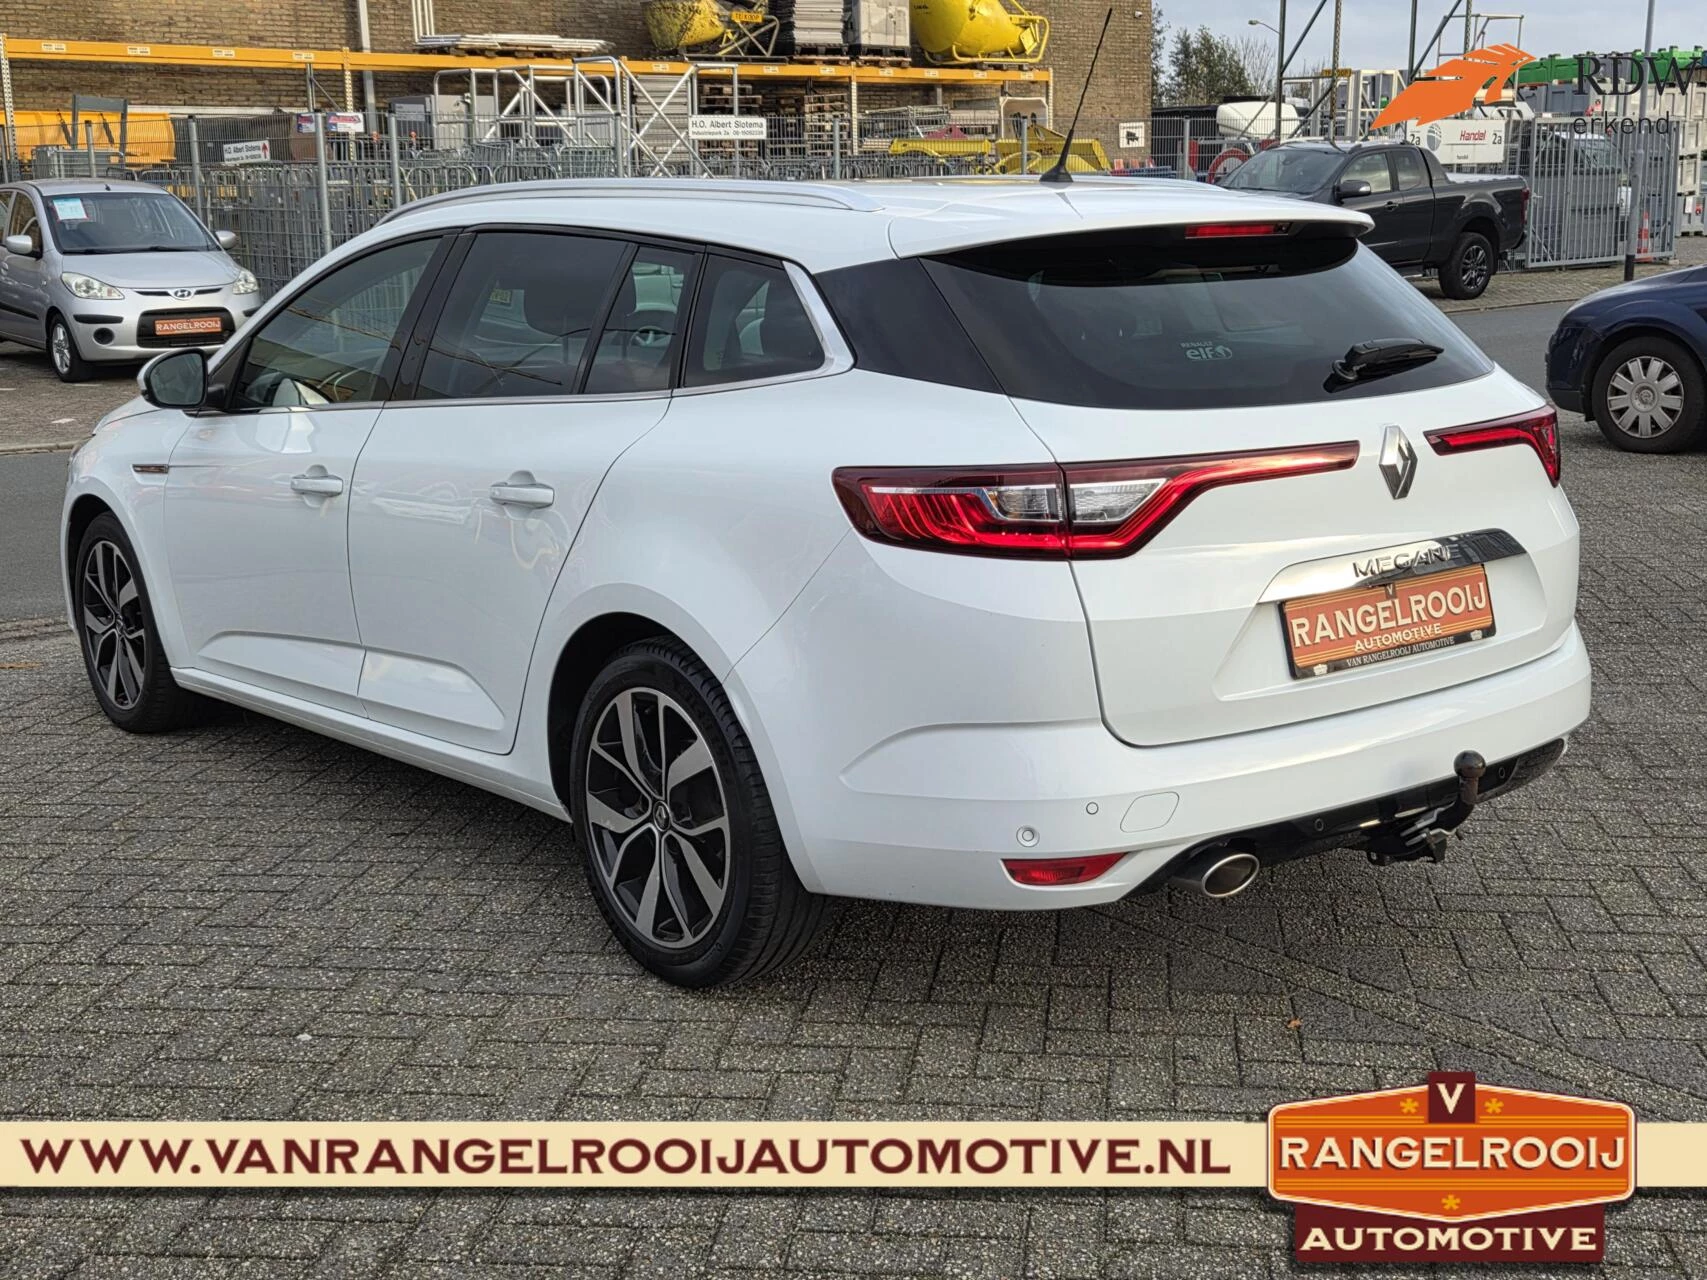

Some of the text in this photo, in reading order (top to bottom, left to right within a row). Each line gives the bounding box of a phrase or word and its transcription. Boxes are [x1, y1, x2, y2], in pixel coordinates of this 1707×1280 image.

[710, 120, 732, 129] Albert
[734, 120, 764, 129] Slotema
[1409, 133, 1421, 146] 2a
[1459, 129, 1487, 141] Handel
[1492, 133, 1502, 145] 2a
[156, 320, 221, 331] RANGELROOIJ
[1186, 347, 1214, 360] elf
[1353, 544, 1459, 578] MEGANE
[1291, 581, 1487, 648] RANGELROOIJ
[1354, 622, 1442, 653] AUTOMOTIVE
[1346, 636, 1455, 668] VAN RANGELROOIJ AUTOMOTIVE
